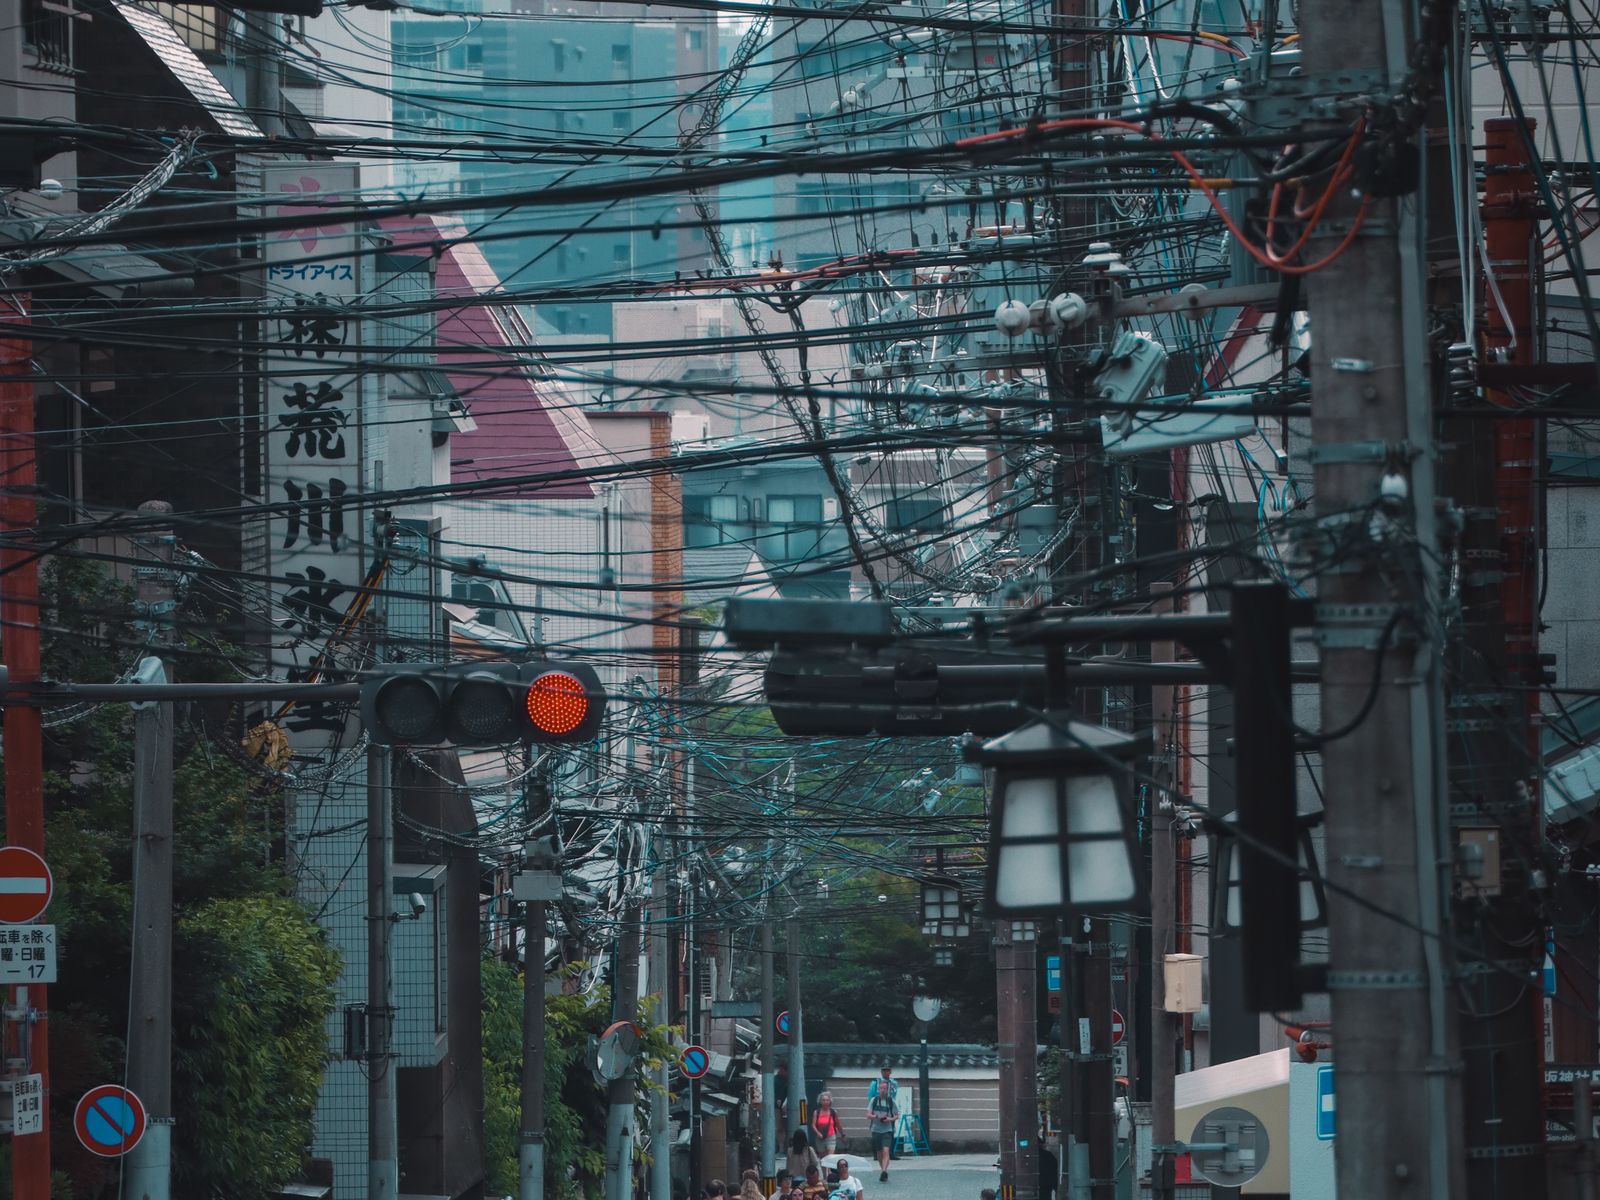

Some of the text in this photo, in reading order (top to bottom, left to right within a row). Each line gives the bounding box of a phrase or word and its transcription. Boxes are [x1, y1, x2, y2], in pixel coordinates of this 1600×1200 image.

[269, 264, 353, 280] ドライアイス
